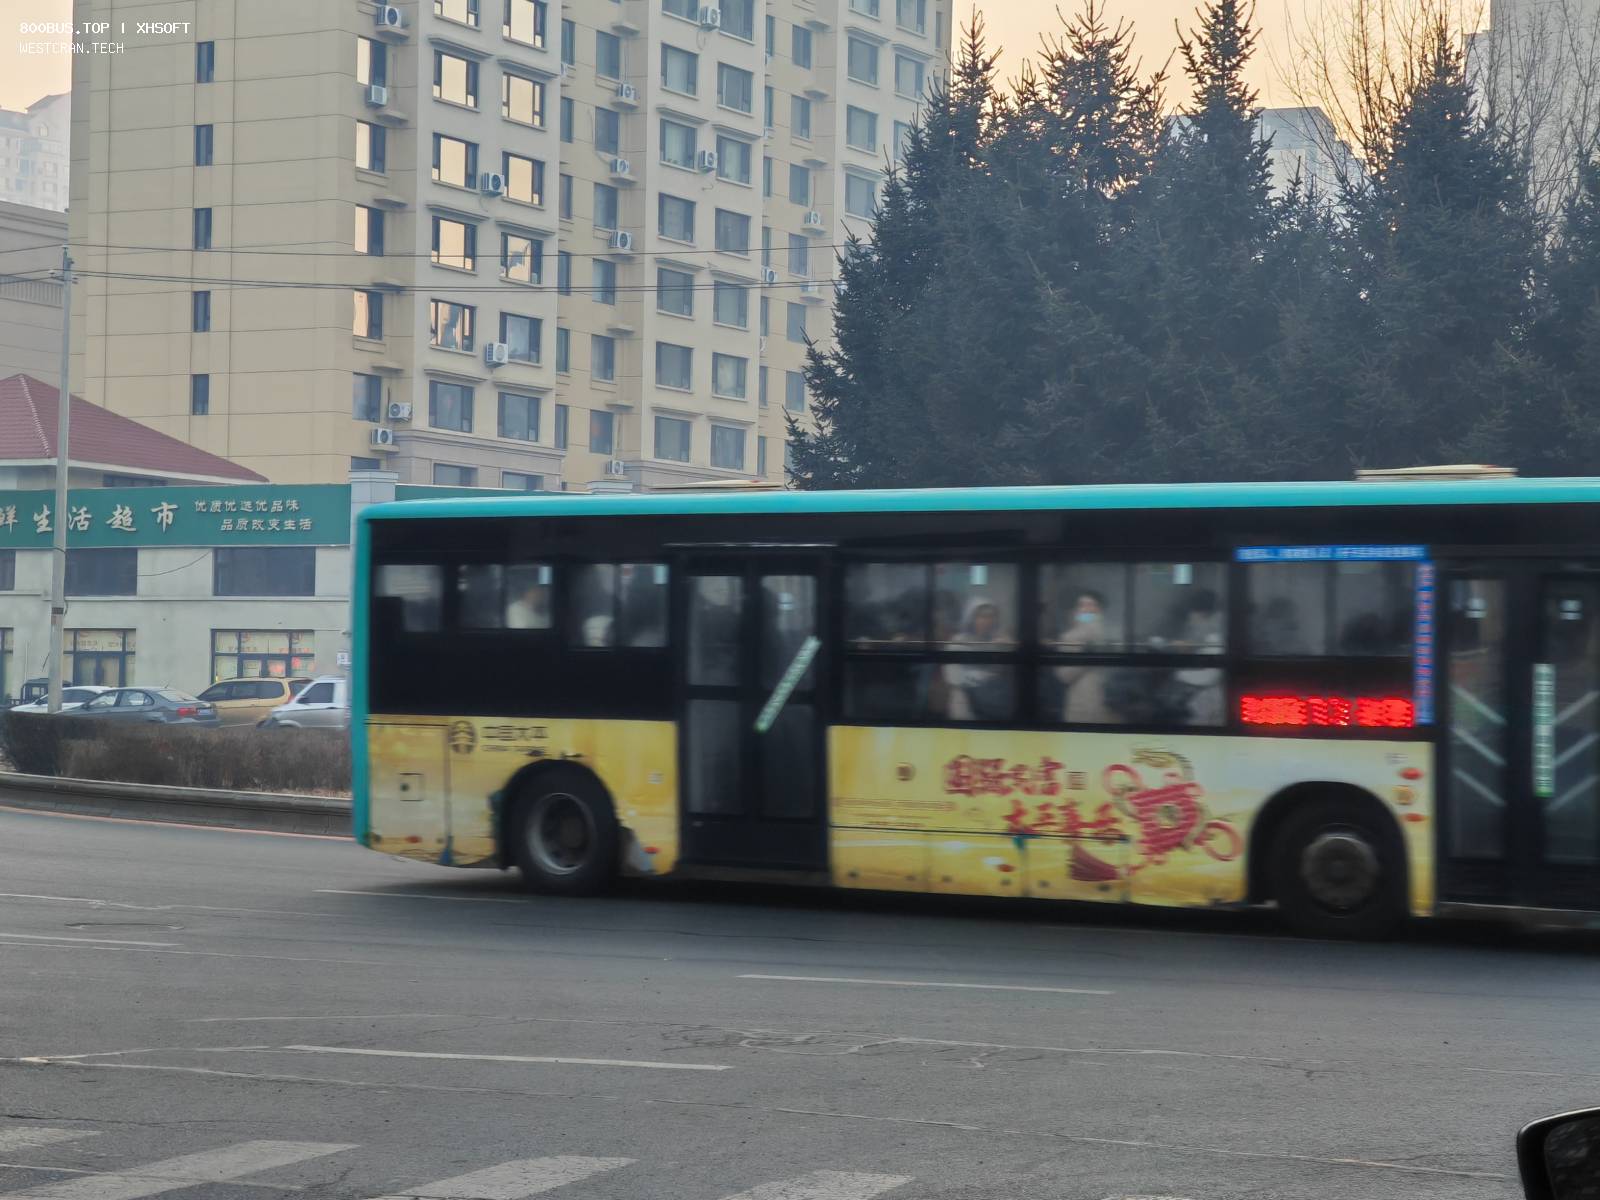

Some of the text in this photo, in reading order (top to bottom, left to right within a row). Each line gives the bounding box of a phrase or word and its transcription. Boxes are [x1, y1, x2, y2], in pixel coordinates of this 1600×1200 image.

[194, 499, 300, 513] 优质优选优品味
[220, 518, 313, 531] 品质改变生活
